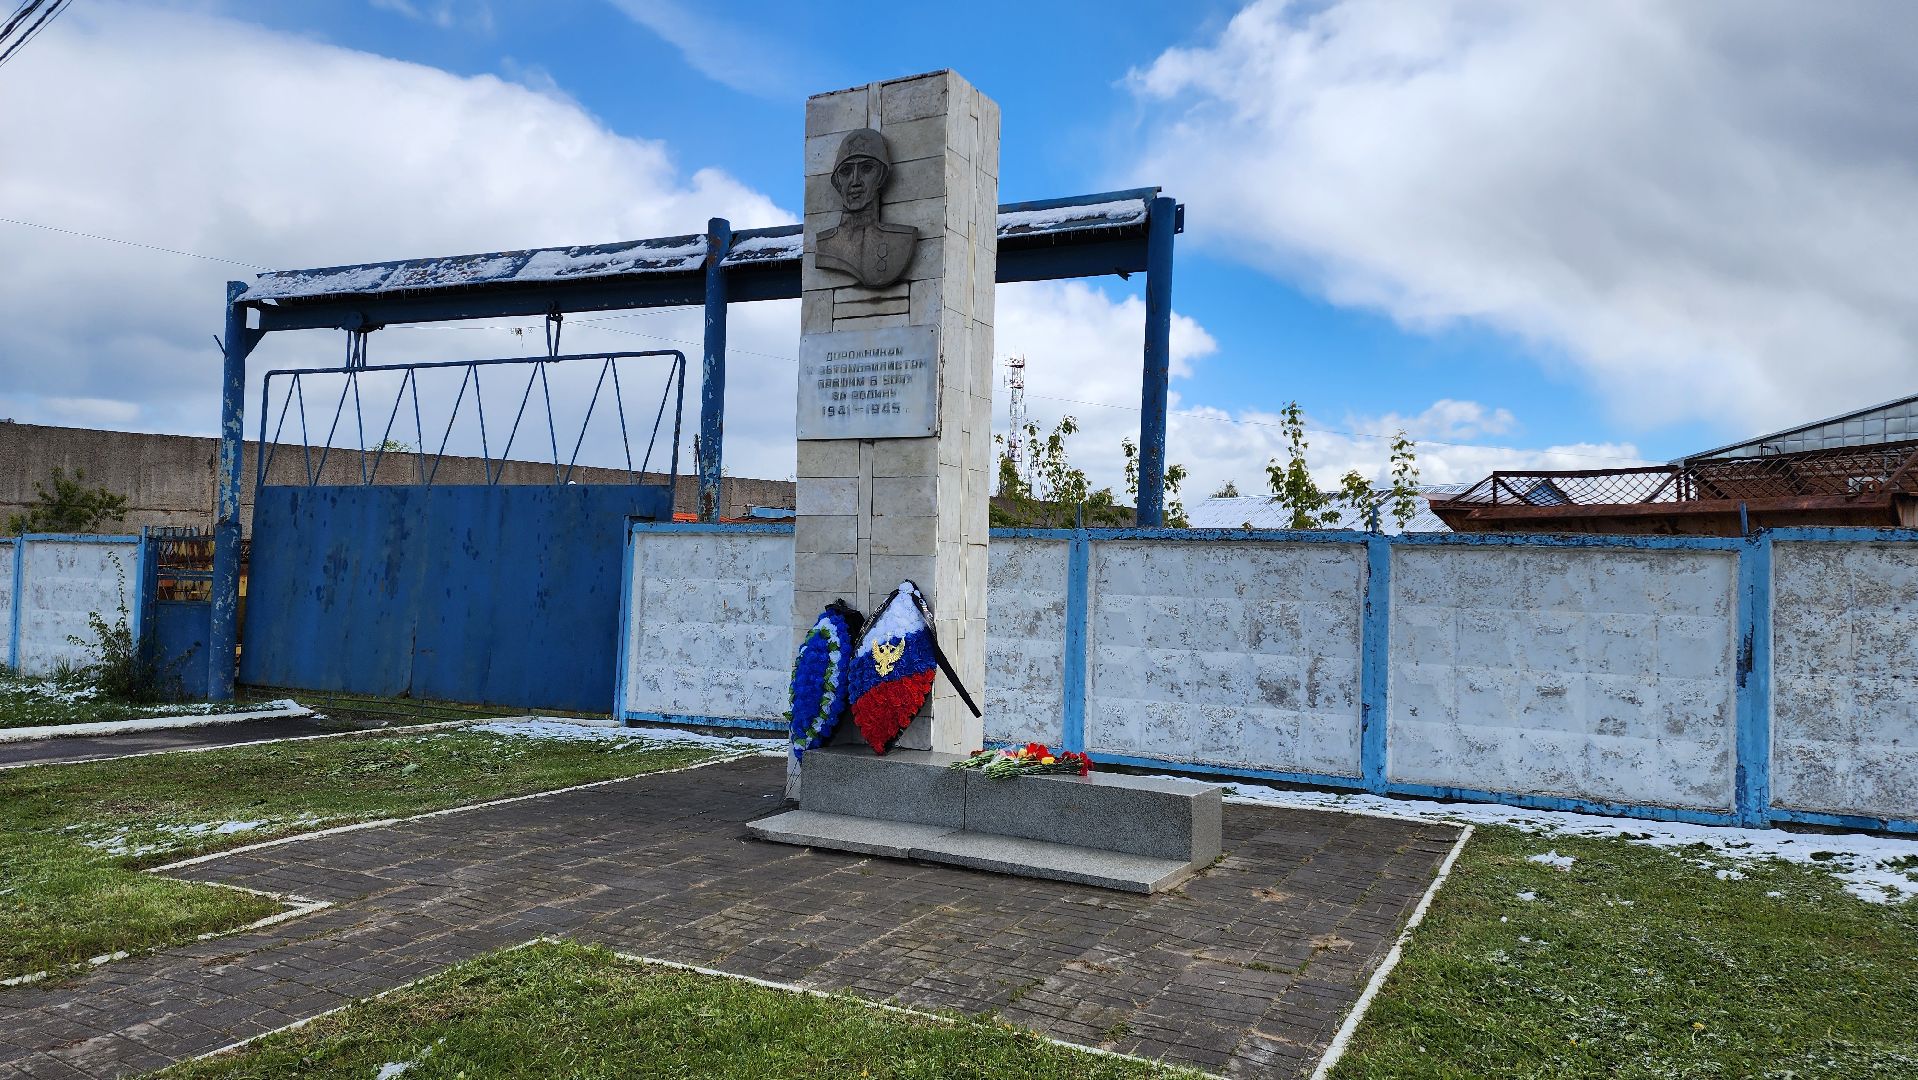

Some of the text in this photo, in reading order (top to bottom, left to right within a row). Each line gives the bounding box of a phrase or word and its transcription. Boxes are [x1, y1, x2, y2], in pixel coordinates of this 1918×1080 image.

[817, 376, 865, 390] ПАВШИМ
[831, 388, 898, 401] ЗА РОДИНУ
